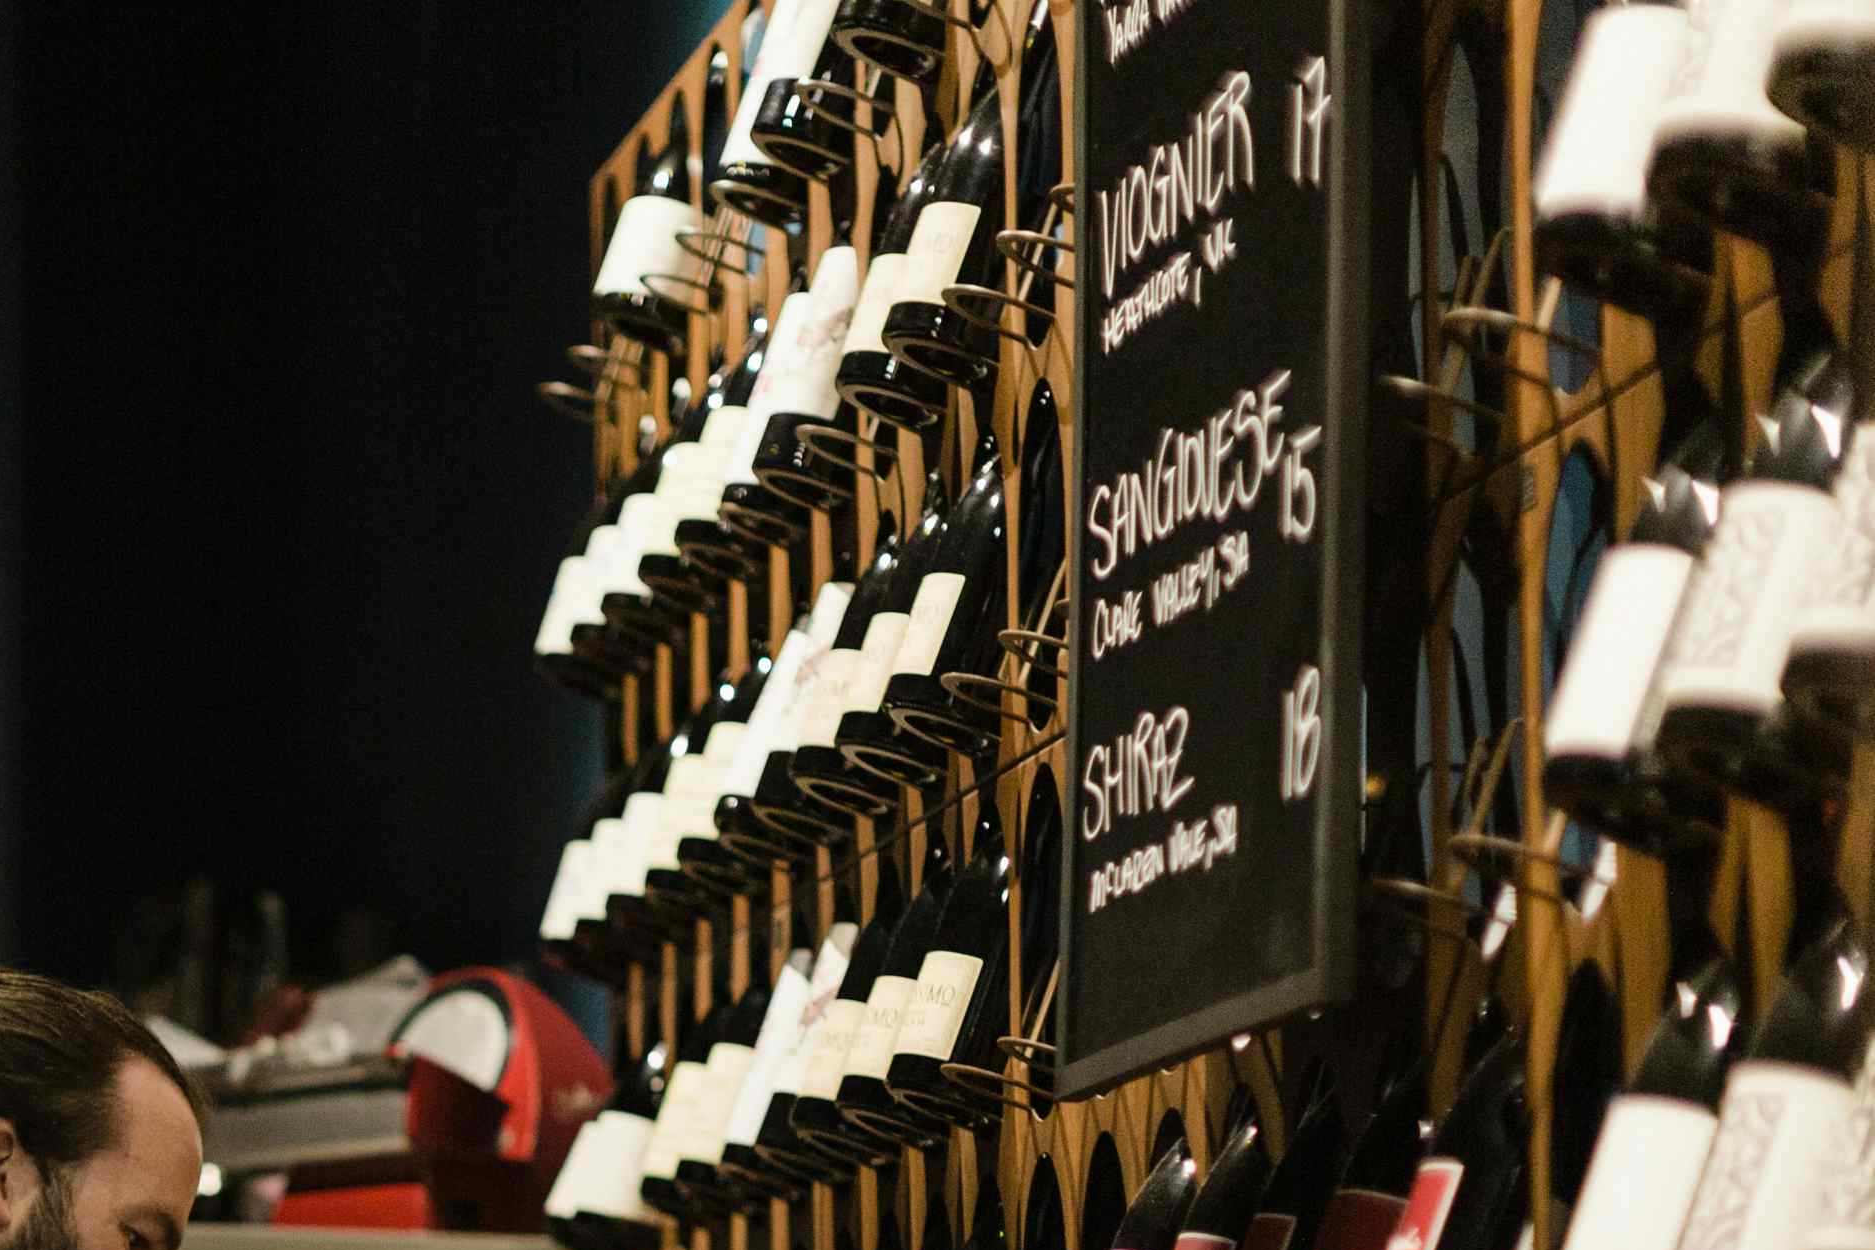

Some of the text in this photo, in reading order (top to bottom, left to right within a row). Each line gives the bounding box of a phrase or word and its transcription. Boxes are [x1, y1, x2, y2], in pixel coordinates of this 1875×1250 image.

[1099, 70, 1254, 300] VIOGNIER
[1088, 369, 1323, 579] SANGIOVESE 15
[1083, 664, 1322, 841] SHIRAZ 18
